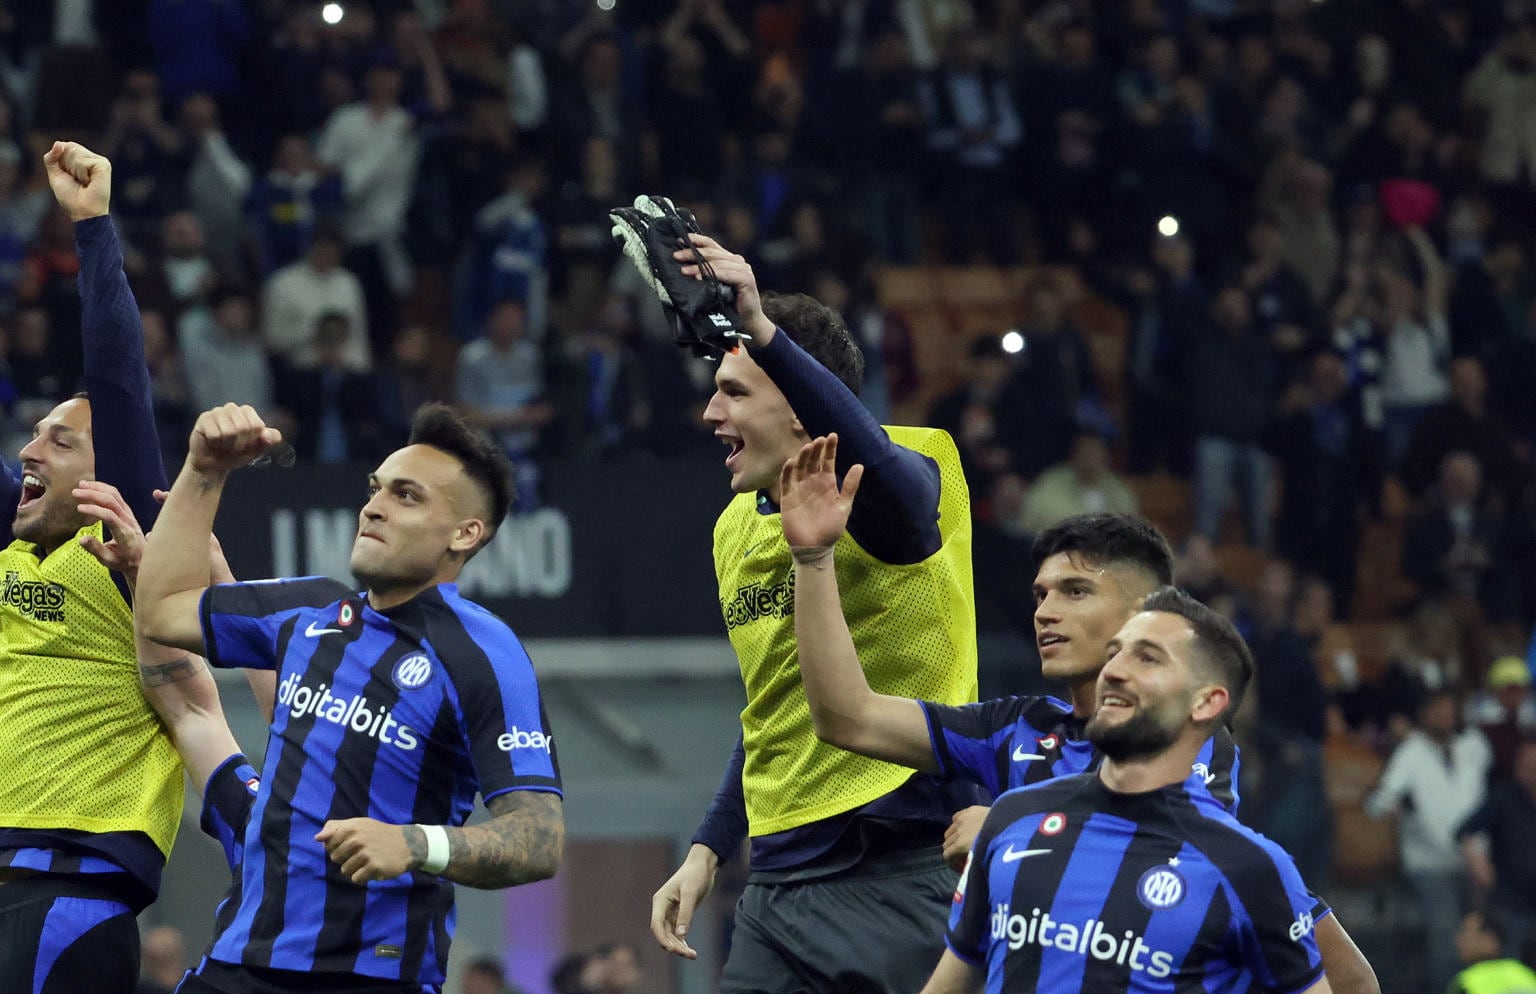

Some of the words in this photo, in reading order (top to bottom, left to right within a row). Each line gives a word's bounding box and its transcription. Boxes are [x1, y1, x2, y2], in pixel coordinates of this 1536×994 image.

[279, 672, 418, 750] digitalbits
[497, 726, 552, 754] ebay
[991, 903, 1174, 977] digitalbits
